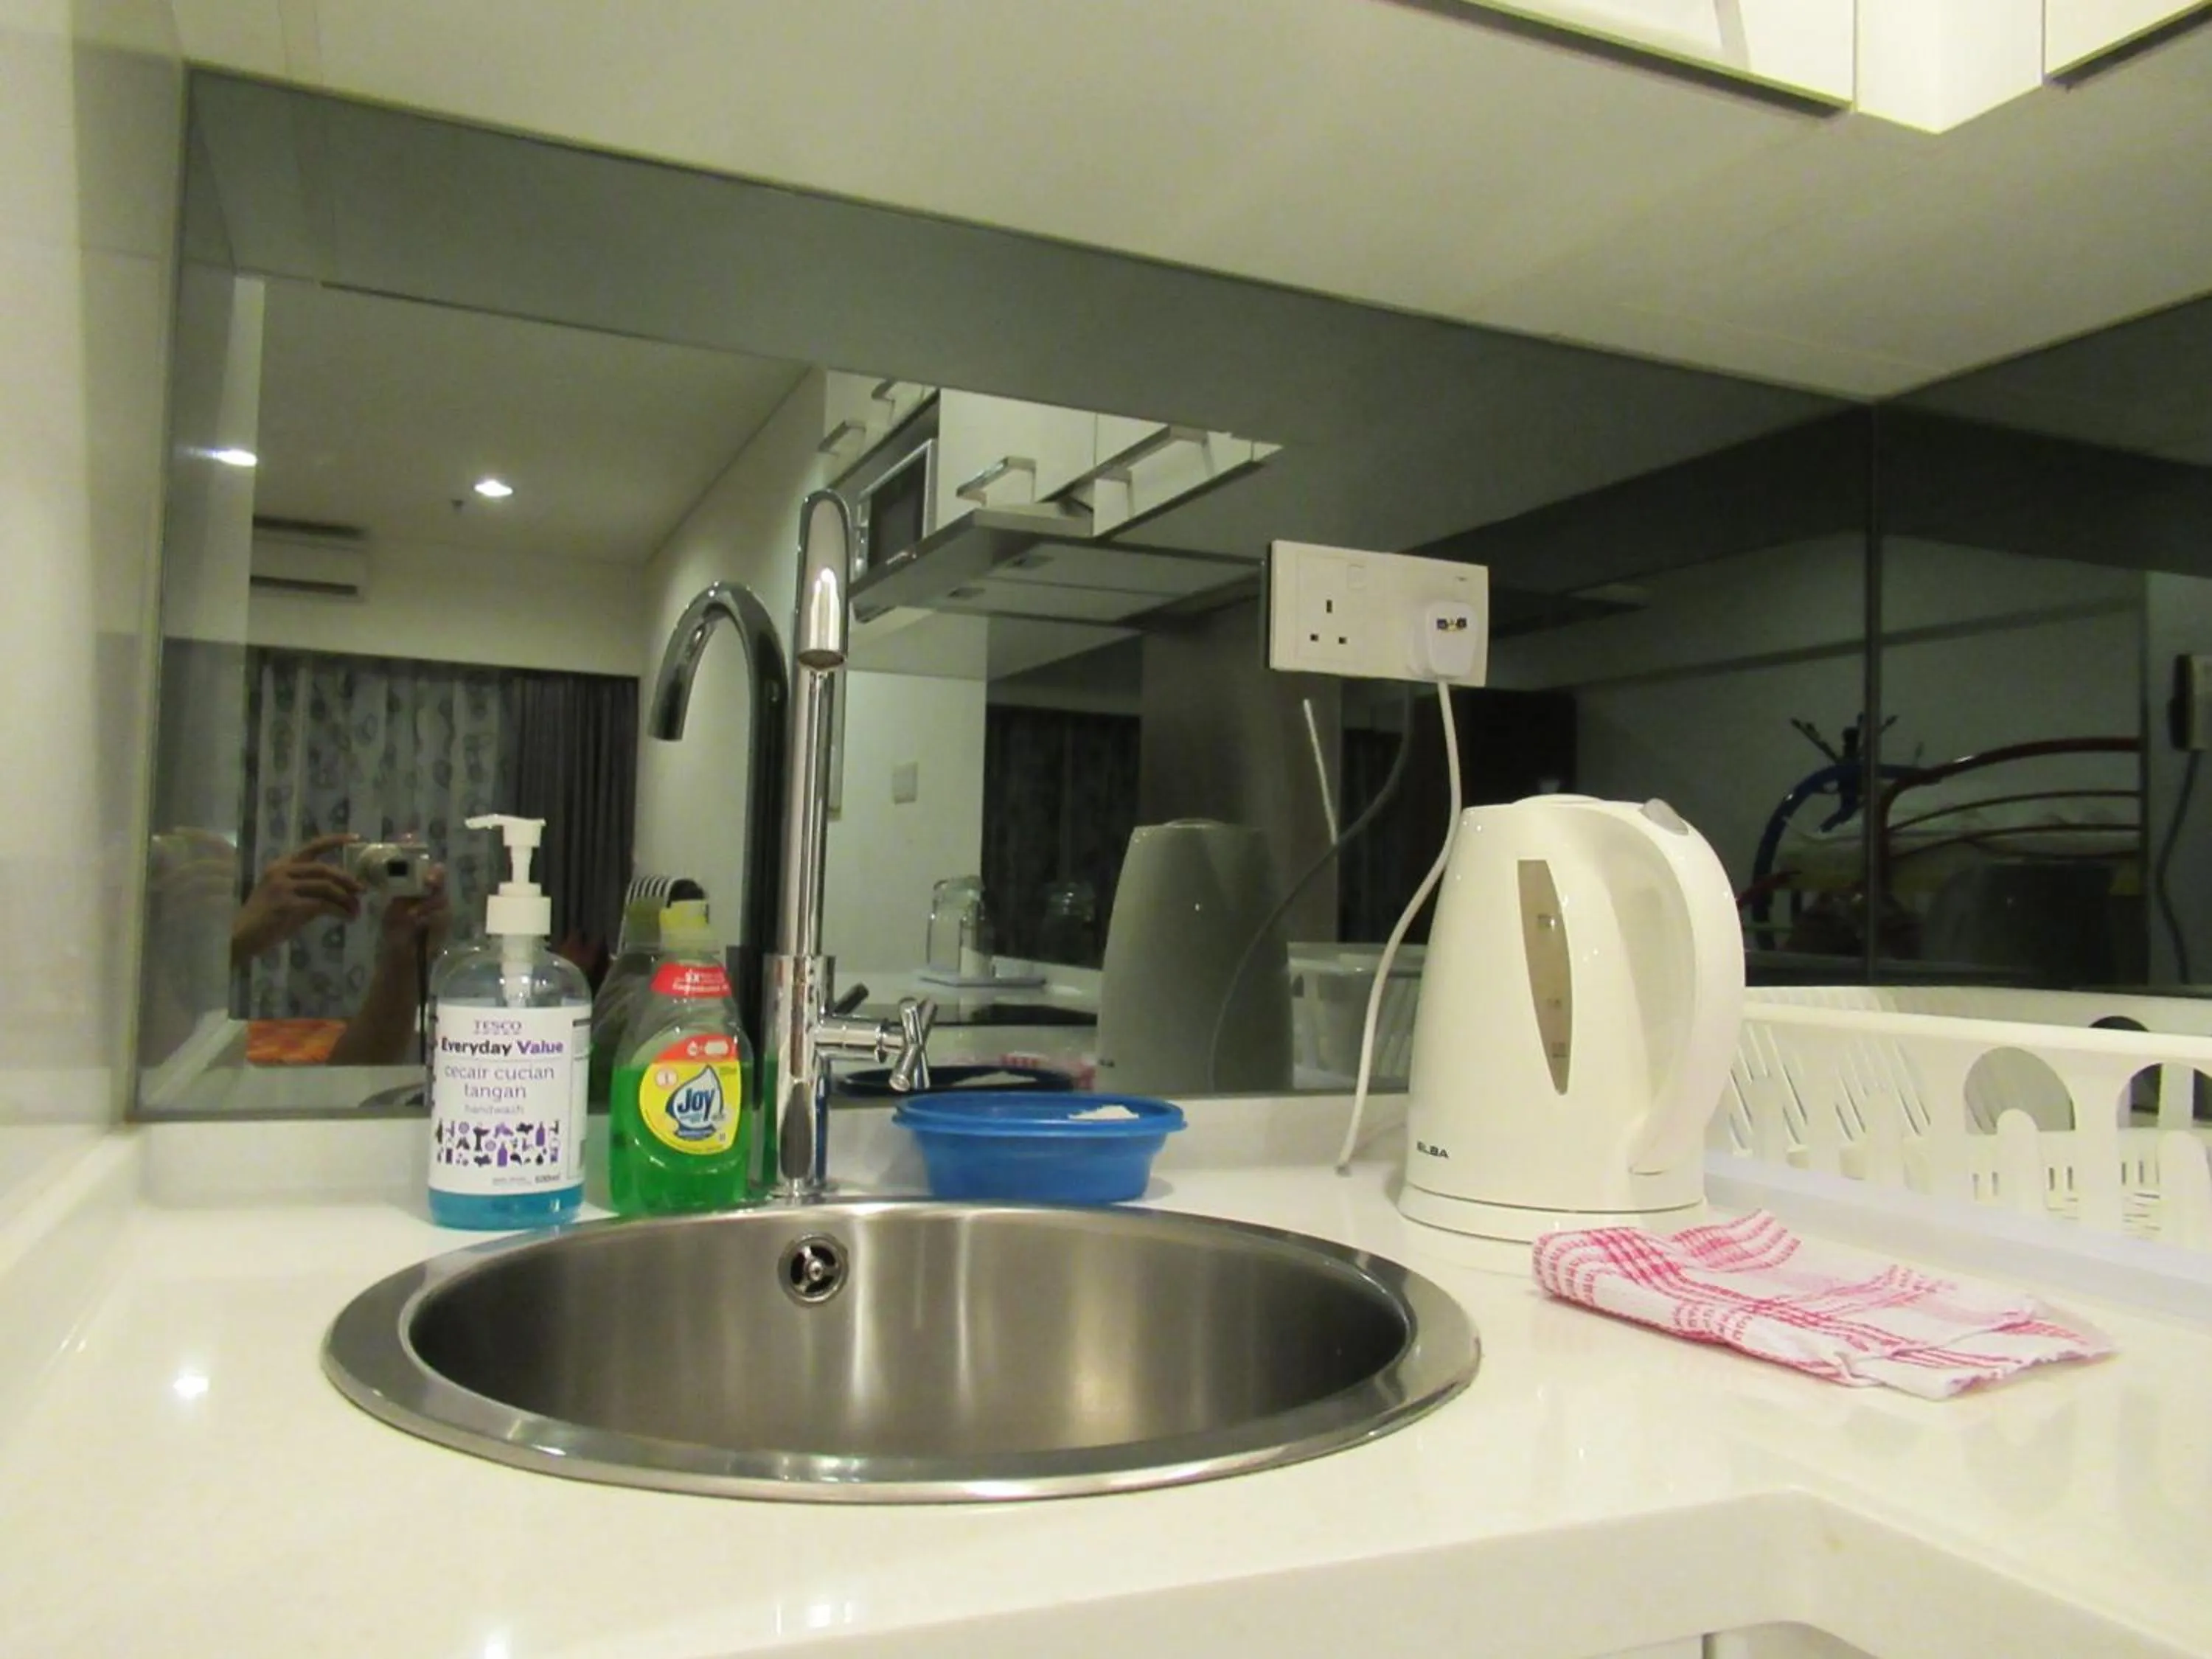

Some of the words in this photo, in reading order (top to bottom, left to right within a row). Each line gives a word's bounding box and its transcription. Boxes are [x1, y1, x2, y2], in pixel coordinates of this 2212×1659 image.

[473, 1020, 522, 1034] TESCO
[442, 1035, 512, 1056] Everyday
[516, 1039, 564, 1054] Value
[444, 1062, 490, 1080] cecair
[493, 1063, 555, 1080] cucian
[464, 1082, 527, 1102] tangan
[677, 1088, 715, 1121] Joy
